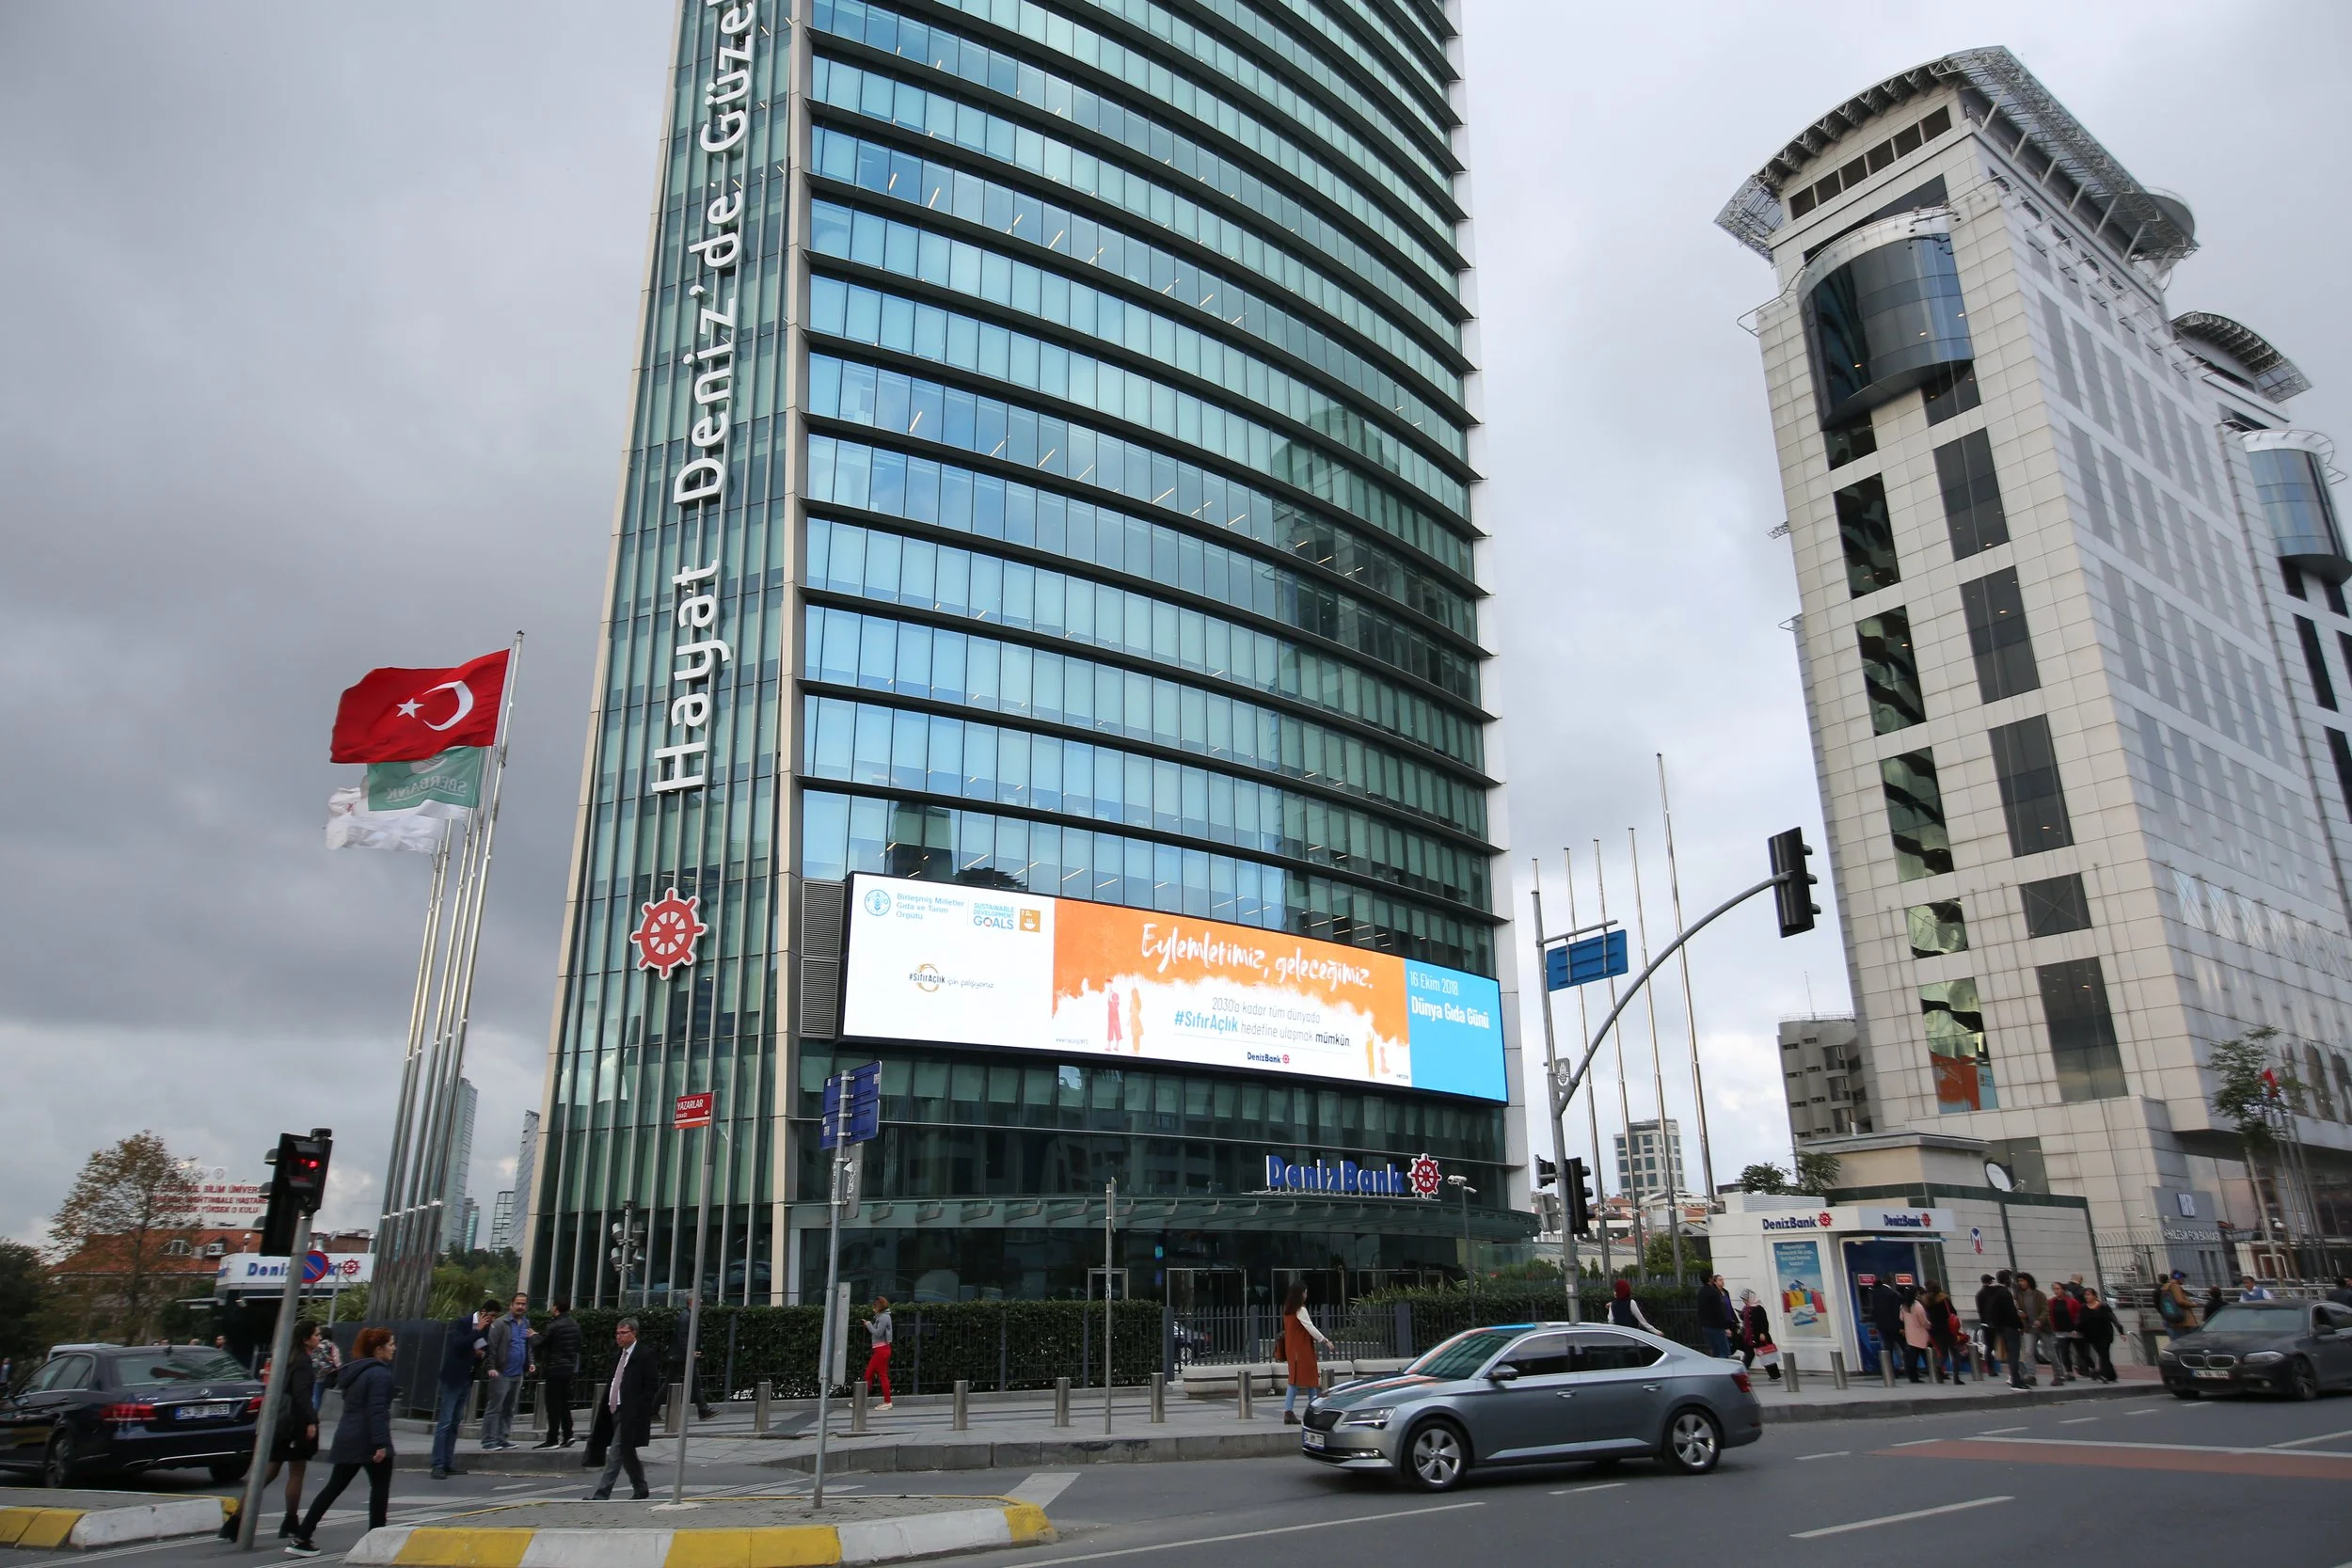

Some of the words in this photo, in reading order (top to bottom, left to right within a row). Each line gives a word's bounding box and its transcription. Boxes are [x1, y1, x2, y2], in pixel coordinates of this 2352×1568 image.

[651, 559, 731, 793] Hayat
[699, 0, 755, 152] Güze
[973, 903, 1015, 912] SUSTAINABLE
[973, 910, 1014, 919] DEVELOPMENT
[973, 915, 1014, 930] GOALS
[1141, 923, 1269, 979] Eylemlerimiz,
[1275, 946, 1374, 992] geleceğimiz.
[1409, 971, 1419, 988] 16
[1420, 973, 1440, 991] Ekim
[1440, 977, 1459, 996] 2018
[1242, 1002, 1266, 1017] kadar
[1269, 1006, 1285, 1019] tüm
[1286, 1007, 1321, 1025] dünyada
[1411, 995, 1443, 1022] Dünya
[1444, 1002, 1466, 1023] Gıda
[1467, 1007, 1490, 1029] Günü
[1174, 1010, 1238, 1035] #SıfırAçlık
[1240, 1021, 1278, 1037] hedefine
[1279, 1026, 1313, 1042] ulaşmak
[1247, 1052, 1281, 1064] DenizBank
[676, 1099, 704, 1110] YAZARLAR
[1265, 1154, 1406, 1194] DenizBank
[1761, 1216, 1817, 1230] DenizBank
[1883, 1213, 1922, 1227] DenizBank
[180, 1407, 190, 1416] 34
